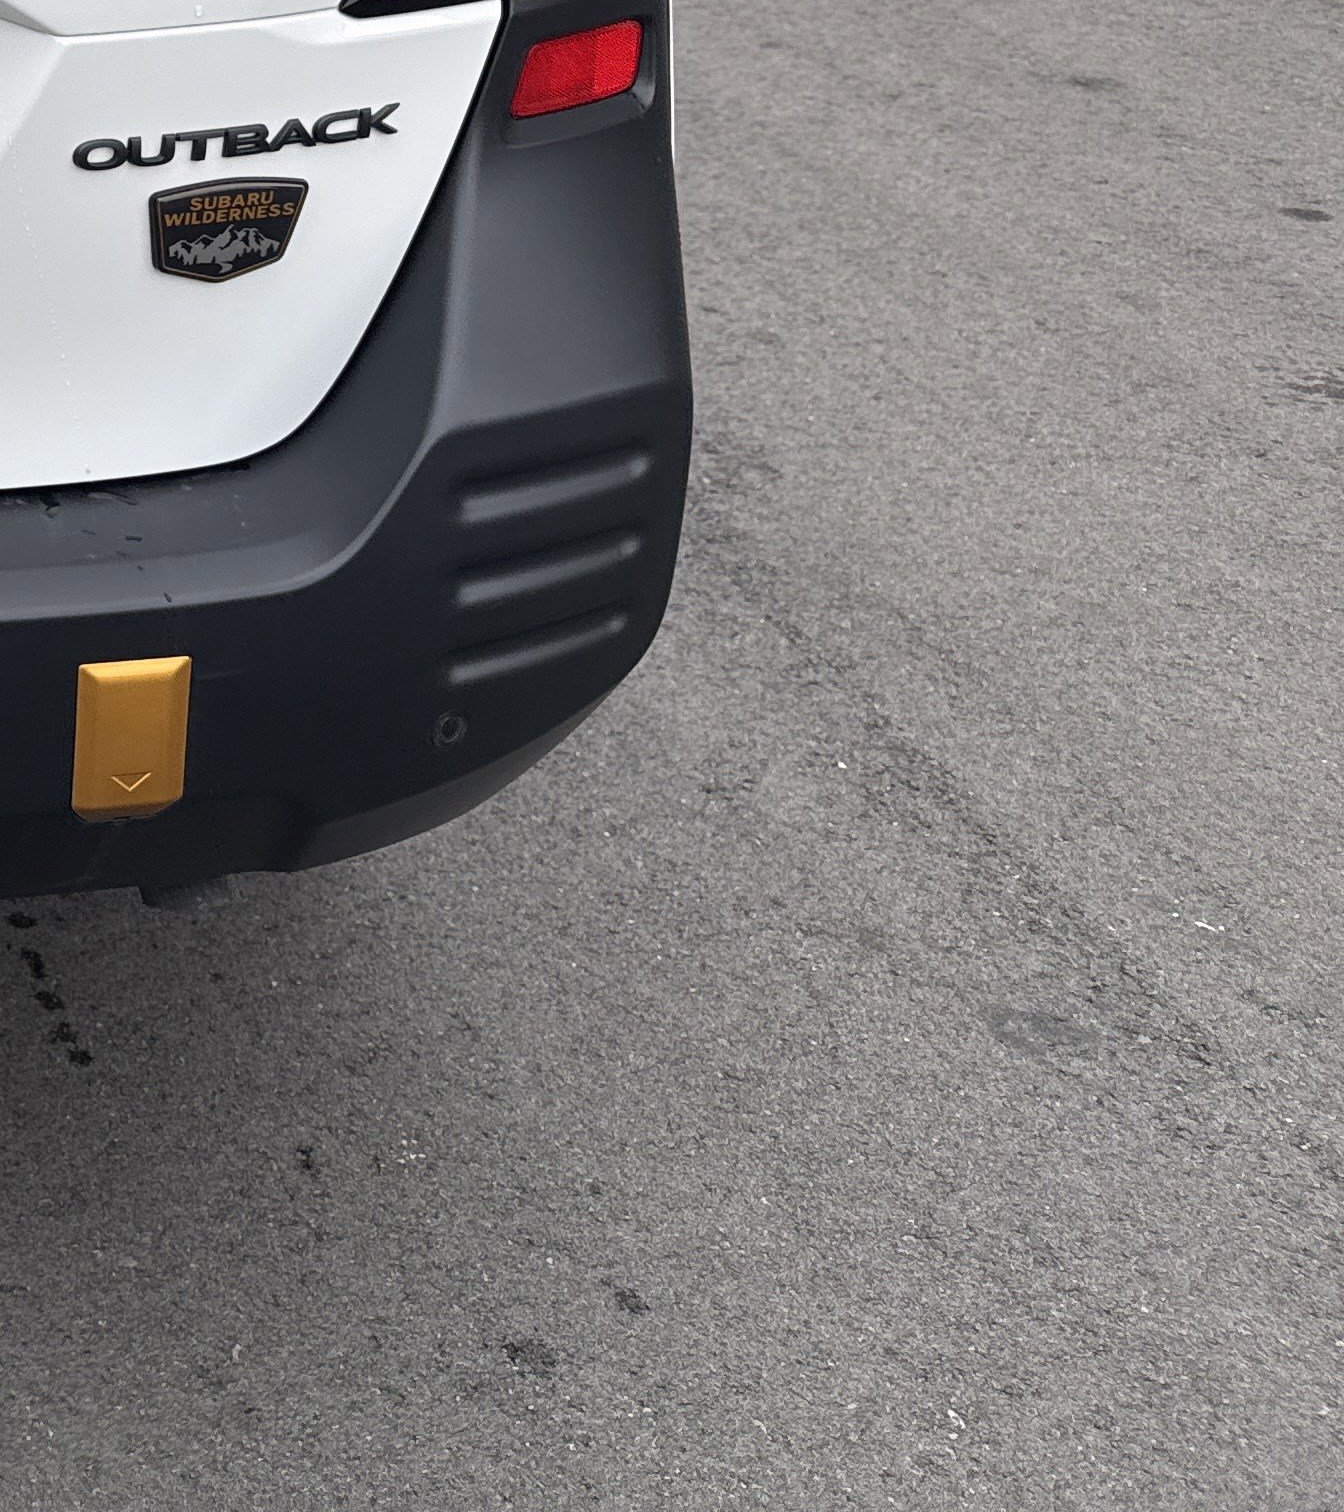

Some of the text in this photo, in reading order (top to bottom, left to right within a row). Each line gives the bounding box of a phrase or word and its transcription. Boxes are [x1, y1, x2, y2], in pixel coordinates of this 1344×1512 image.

[72, 102, 401, 171] OUTBACK
[189, 189, 275, 212] SUBARU
[164, 201, 295, 228] WILDERNESS
